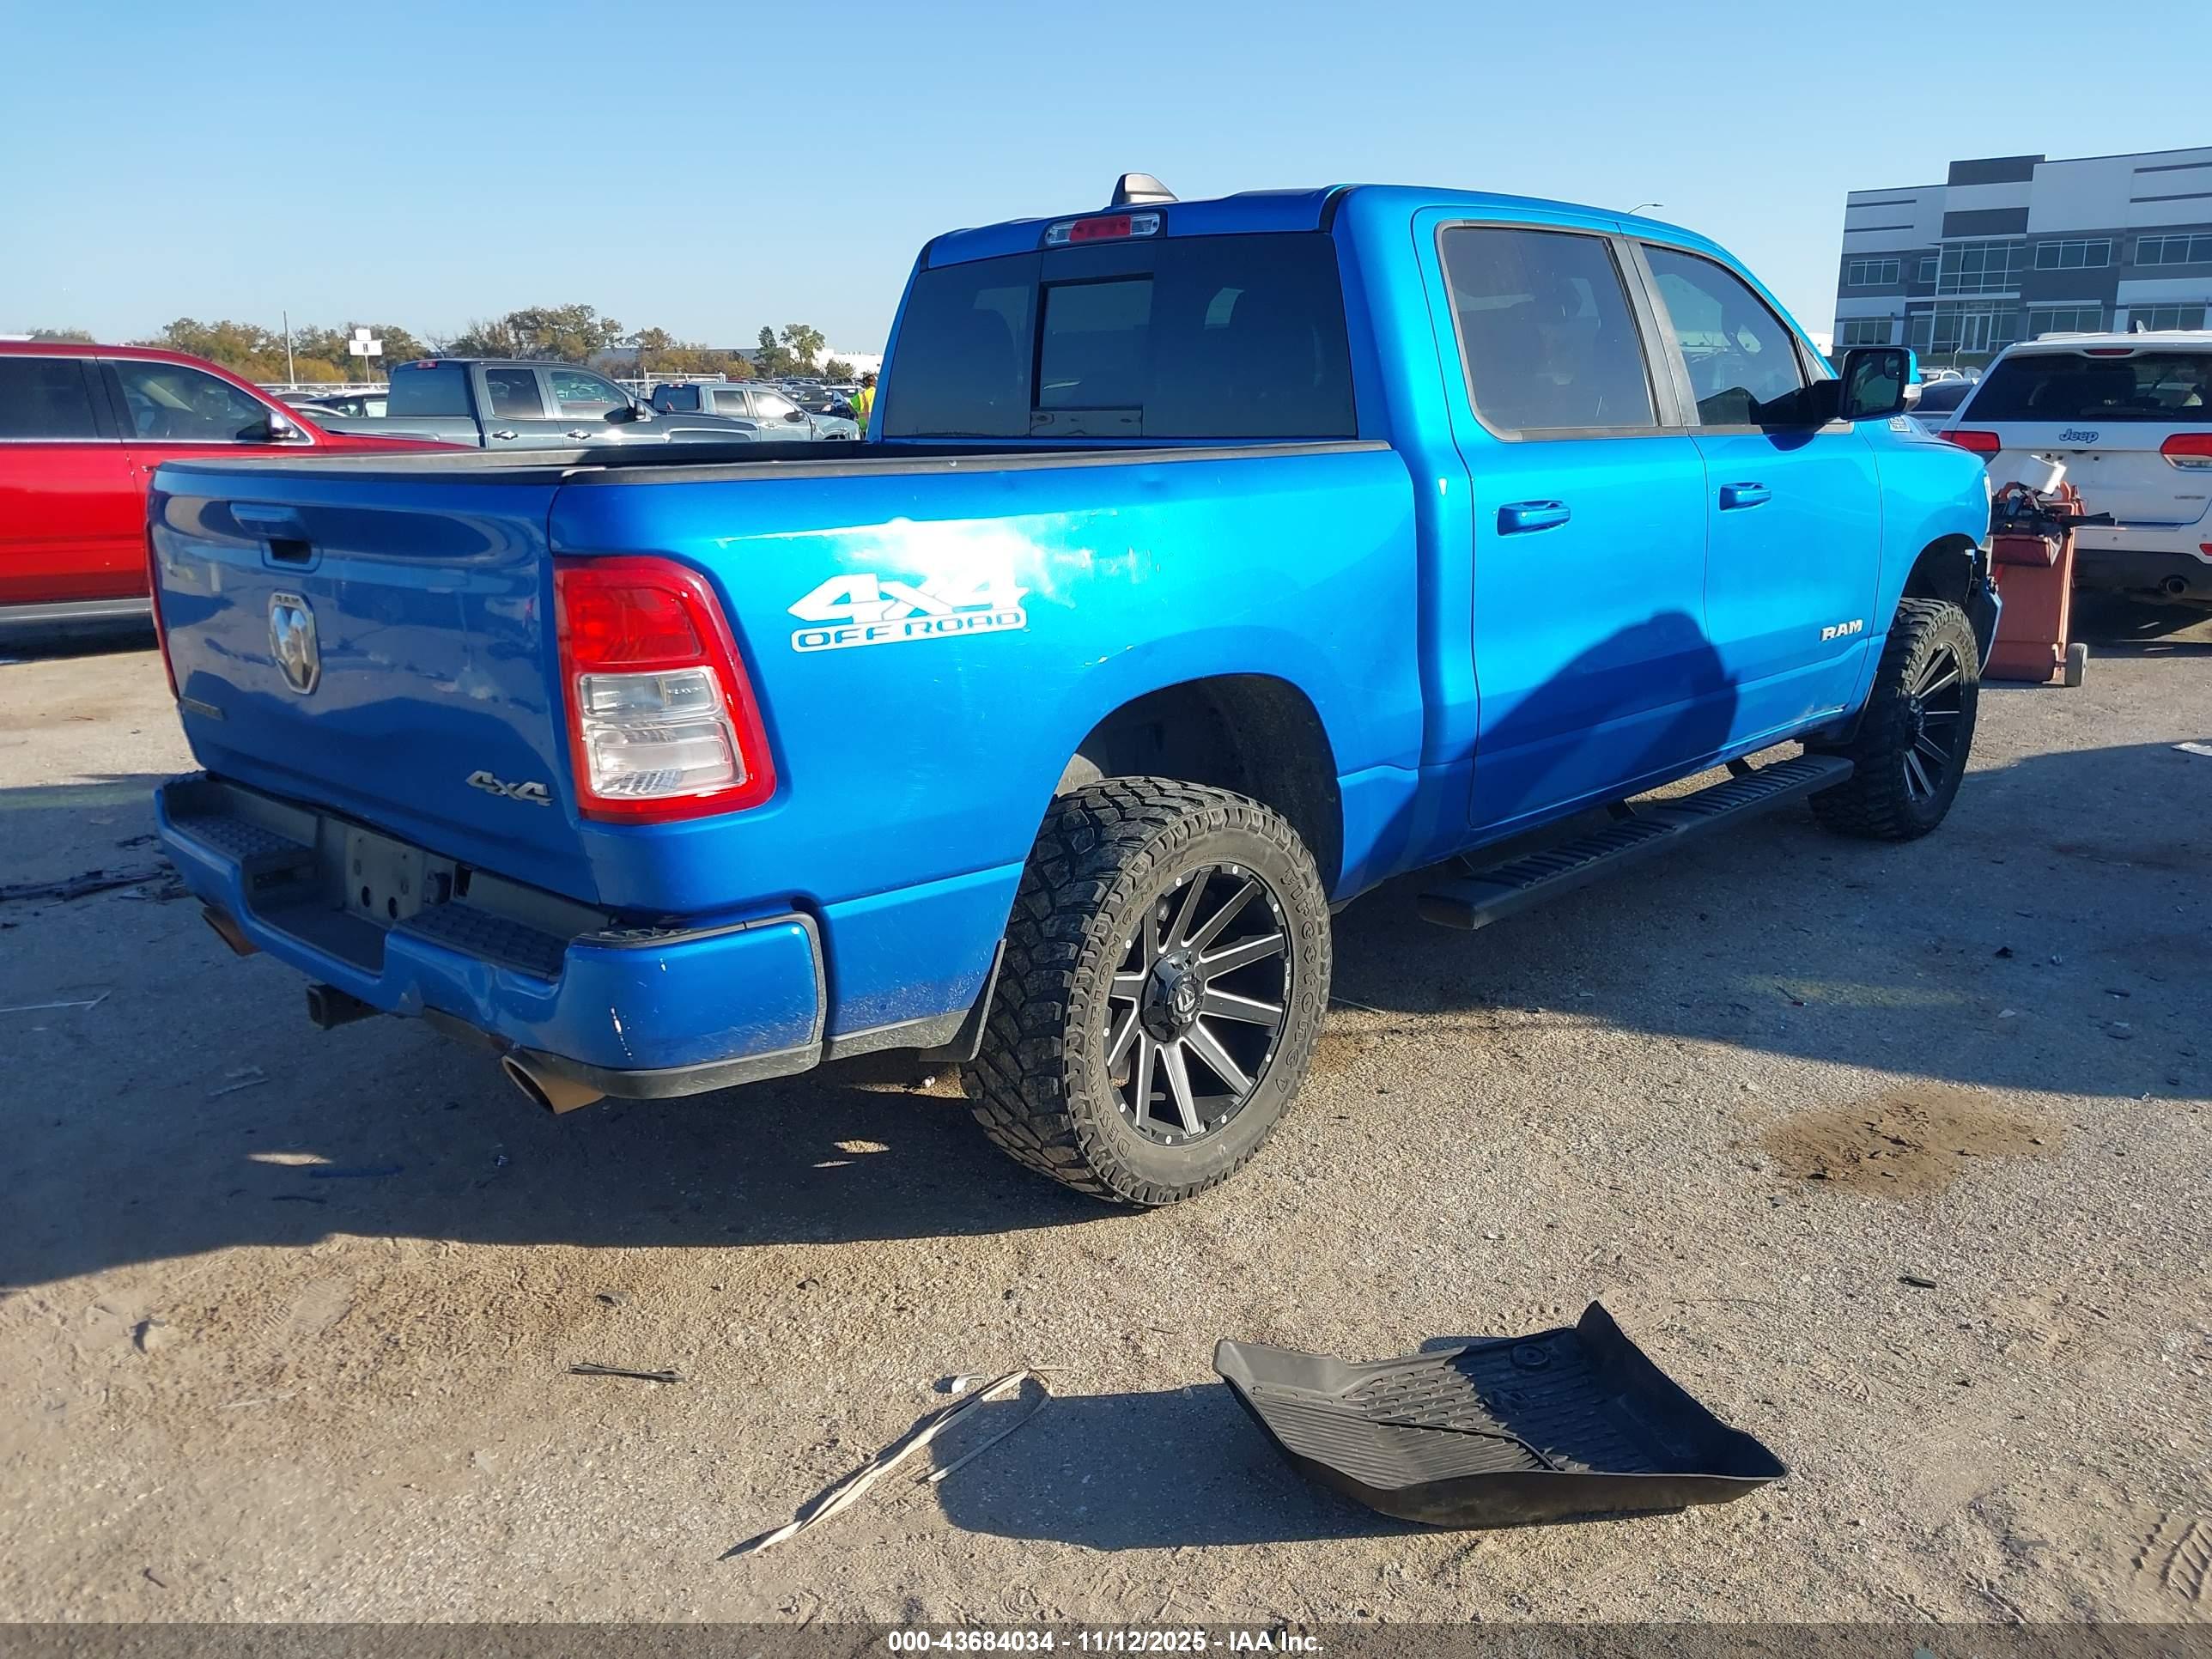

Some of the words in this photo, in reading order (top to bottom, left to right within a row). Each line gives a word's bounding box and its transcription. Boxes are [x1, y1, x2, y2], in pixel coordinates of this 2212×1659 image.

[2058, 428, 2100, 443] Jeep
[798, 624, 892, 647] OFF
[903, 611, 1021, 636] ROAD
[1820, 619, 1863, 642] RAM
[1088, 933, 1131, 1158] DESTINATION
